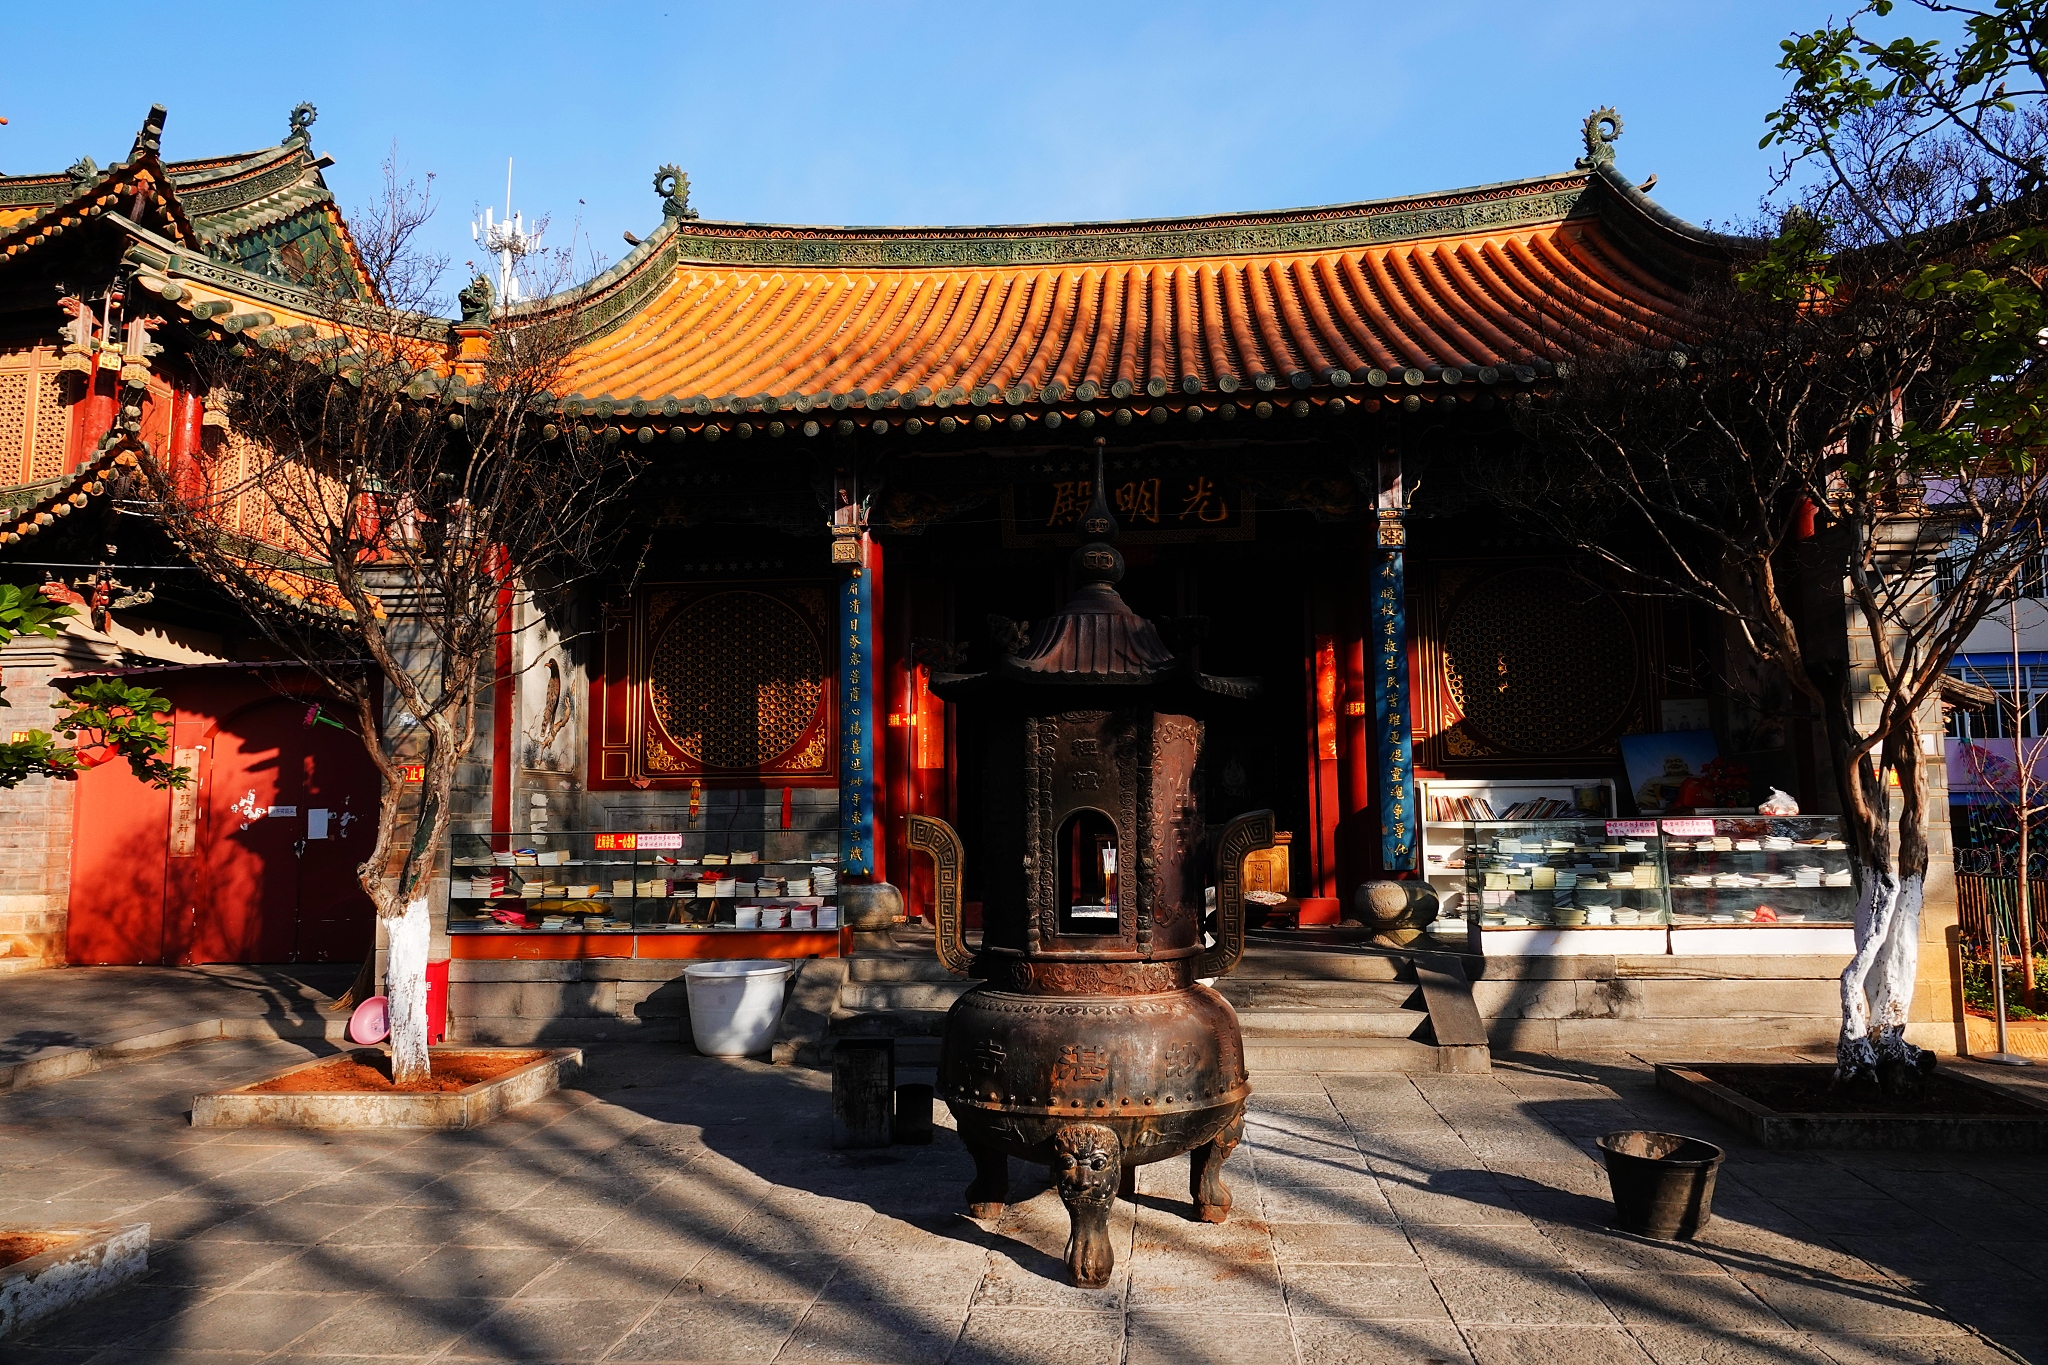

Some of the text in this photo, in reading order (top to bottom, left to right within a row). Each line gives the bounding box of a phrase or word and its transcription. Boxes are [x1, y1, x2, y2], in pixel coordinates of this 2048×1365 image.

[1046, 476, 1229, 527] 光明殿
[12, 732, 30, 743] 禁止
[974, 1039, 1201, 1082] 妙湛寺
